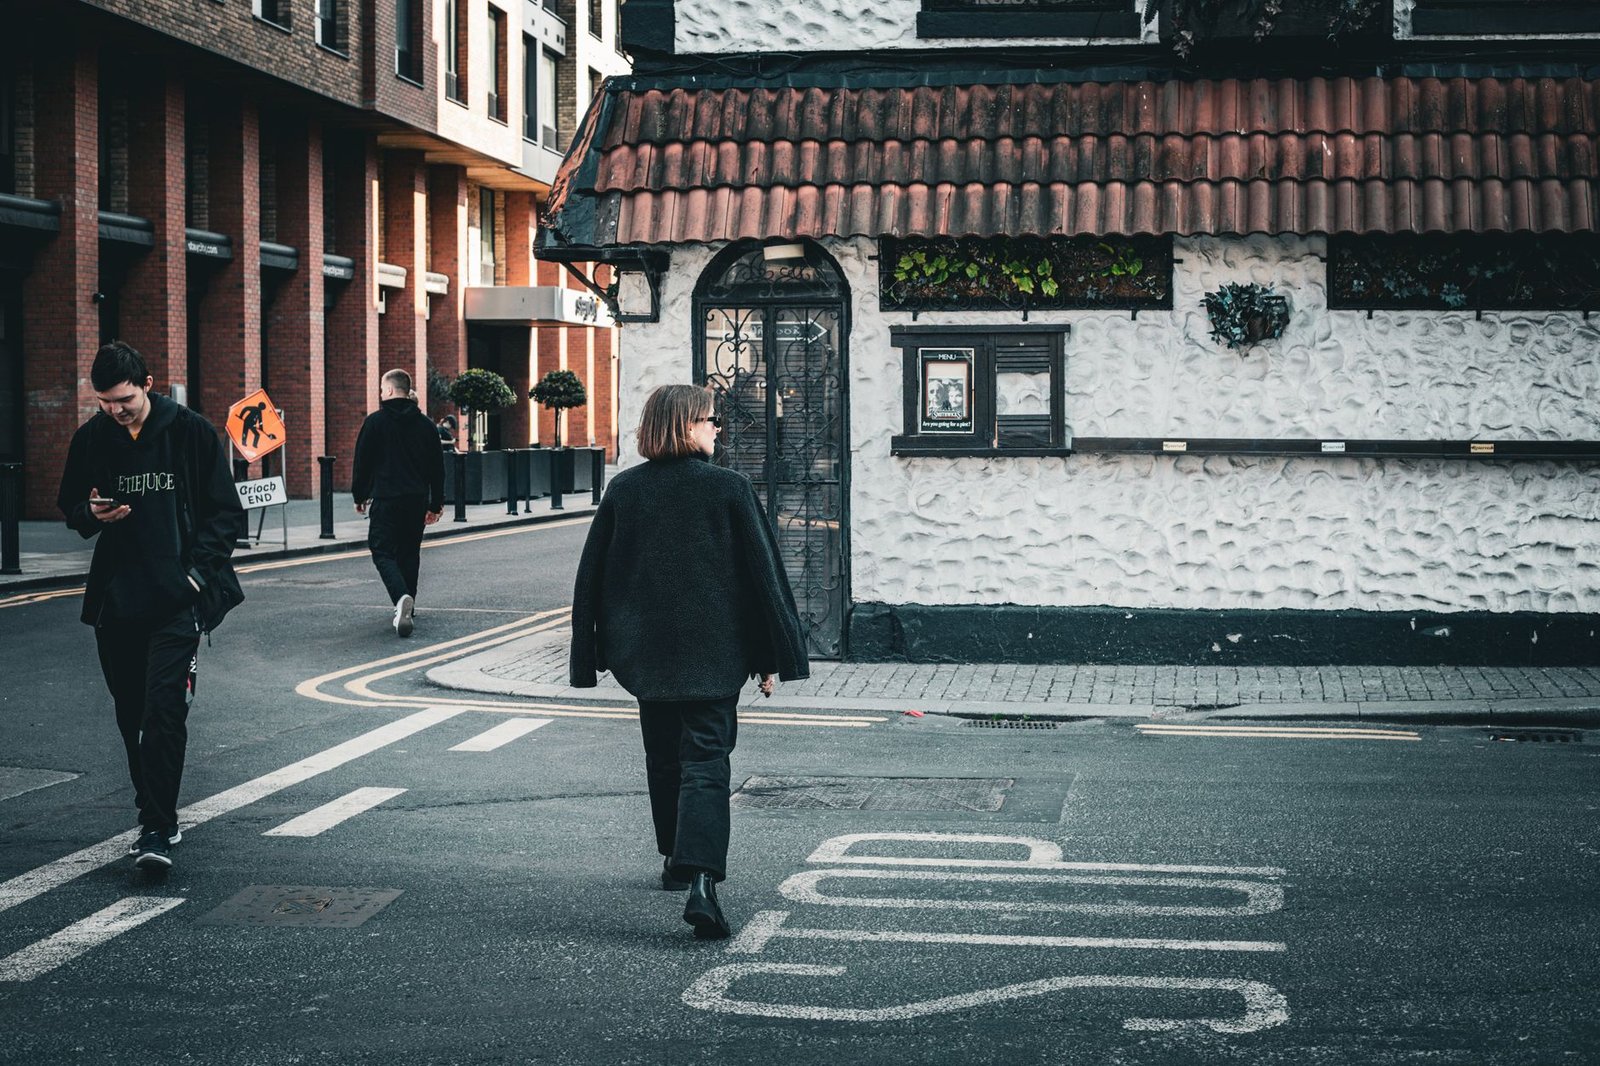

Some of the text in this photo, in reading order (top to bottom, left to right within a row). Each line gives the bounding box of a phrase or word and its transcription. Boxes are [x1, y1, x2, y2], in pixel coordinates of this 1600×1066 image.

[117, 472, 176, 497] ETLEJUICE
[247, 493, 272, 505] END
[681, 832, 1291, 1035] STOP
